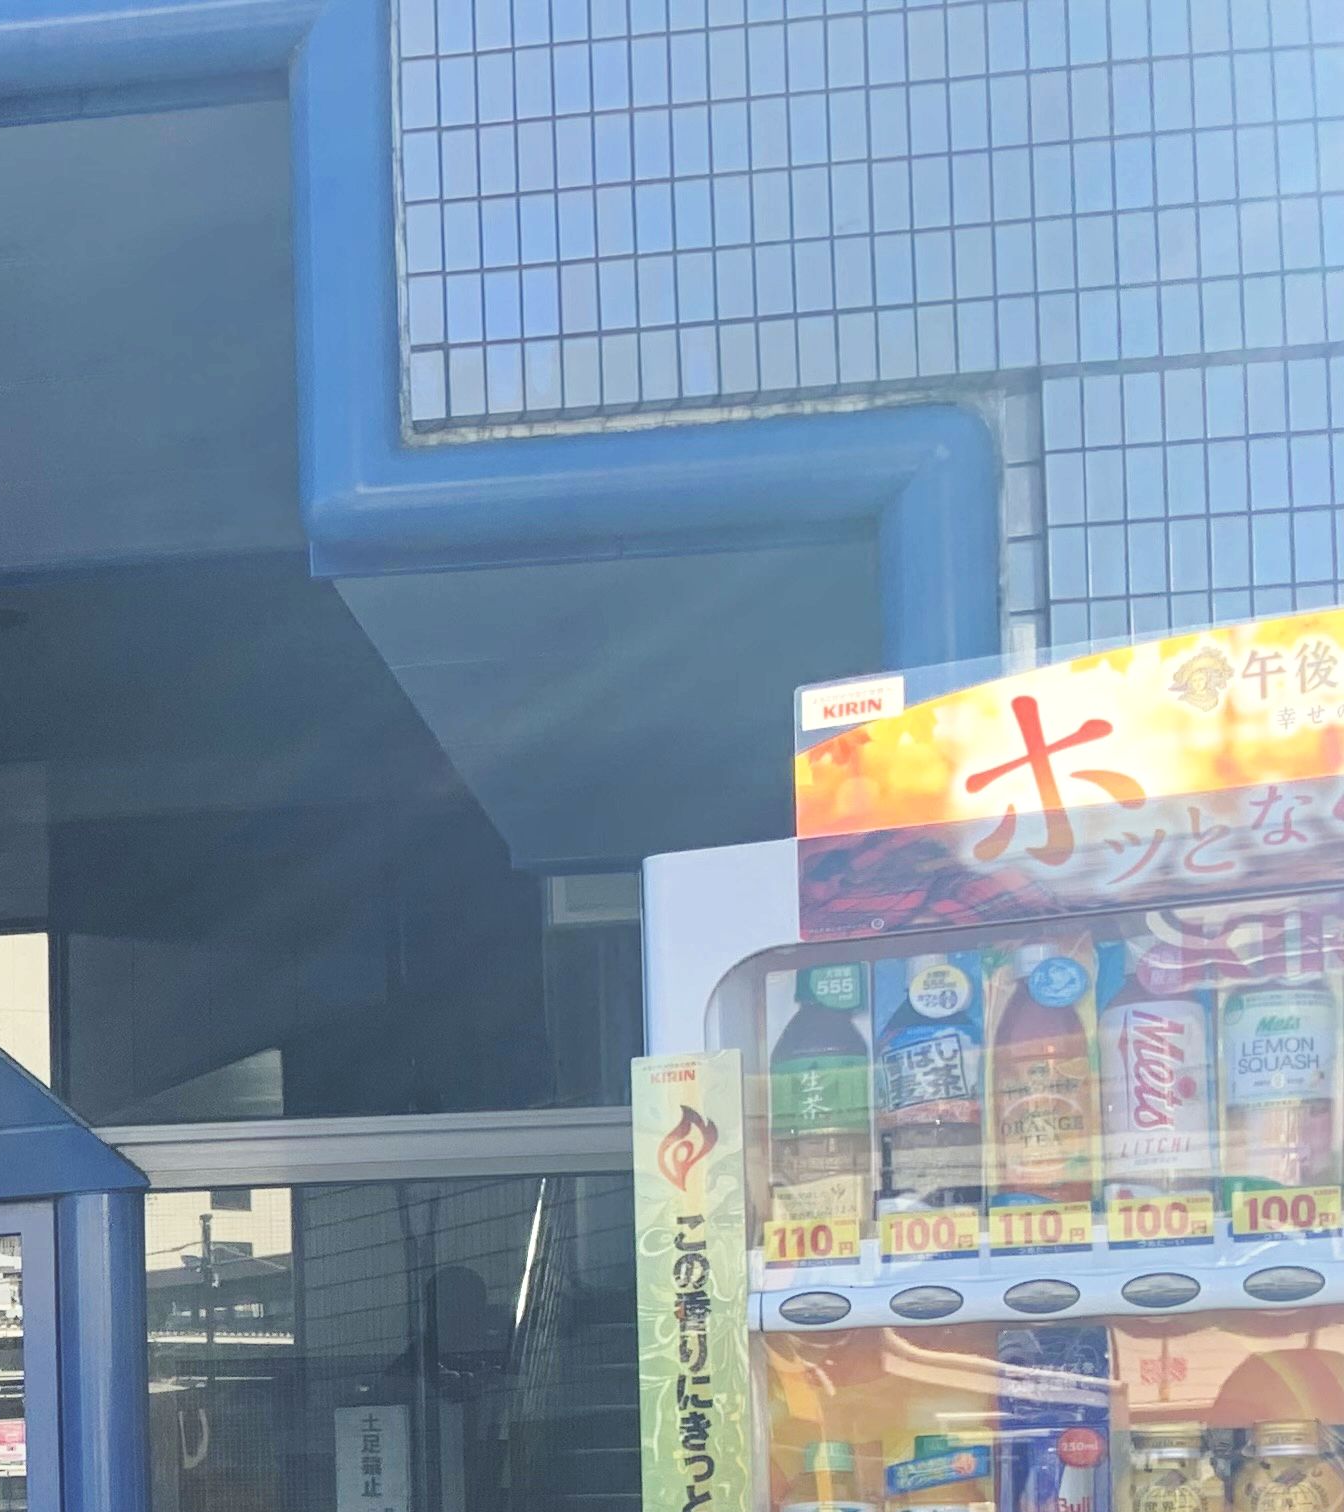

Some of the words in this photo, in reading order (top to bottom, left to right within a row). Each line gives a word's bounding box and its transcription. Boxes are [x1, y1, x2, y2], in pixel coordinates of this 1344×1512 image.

[823, 698, 883, 720] KIRIN
[816, 978, 854, 996] 555
[1241, 1037, 1315, 1057] LEMON
[1238, 1055, 1320, 1075] SQUASH
[650, 1070, 696, 1084] KIRIN
[798, 1070, 834, 1120] 生茶
[1000, 1115, 1084, 1137] ORANGE
[1020, 1134, 1064, 1148] TEA
[1119, 1137, 1191, 1159] LITCHI
